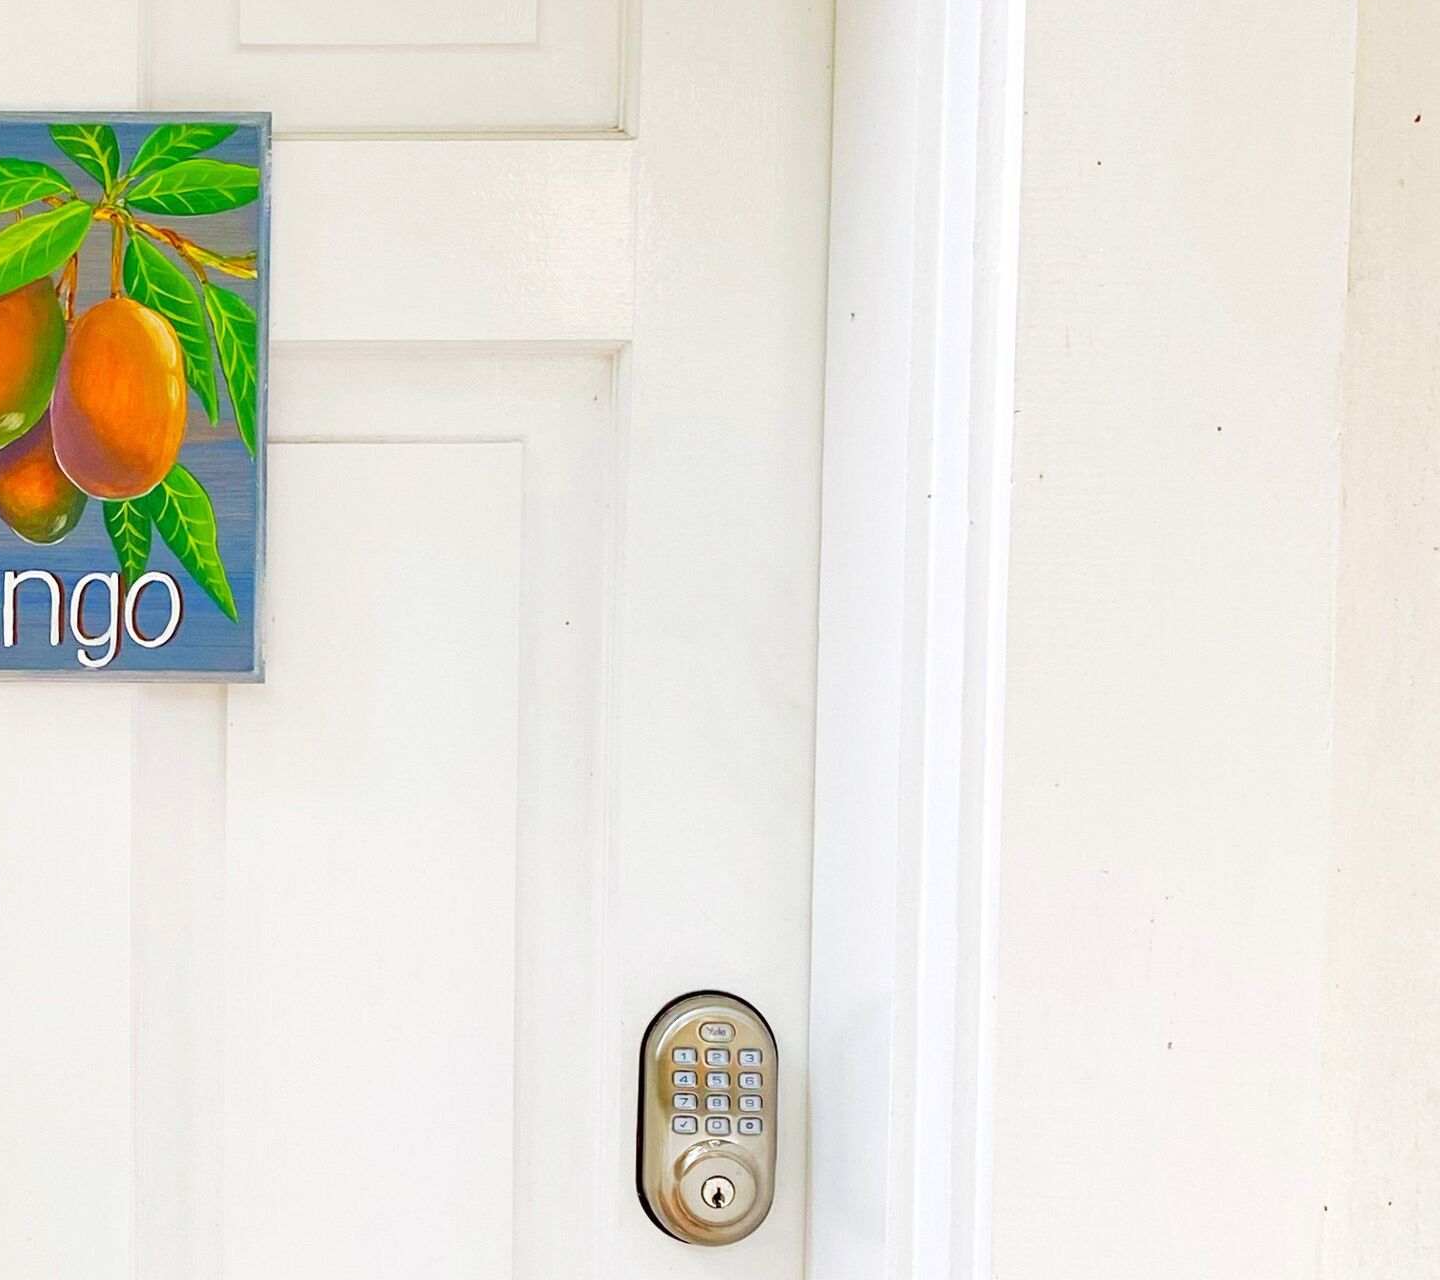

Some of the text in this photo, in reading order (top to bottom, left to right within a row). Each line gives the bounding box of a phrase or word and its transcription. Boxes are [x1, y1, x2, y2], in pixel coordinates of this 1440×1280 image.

[744, 1053, 754, 1062] 3
[679, 1075, 755, 1085] 4 5 6
[679, 1097, 755, 1107] 7 8 9
[712, 1120, 722, 1129] 0
